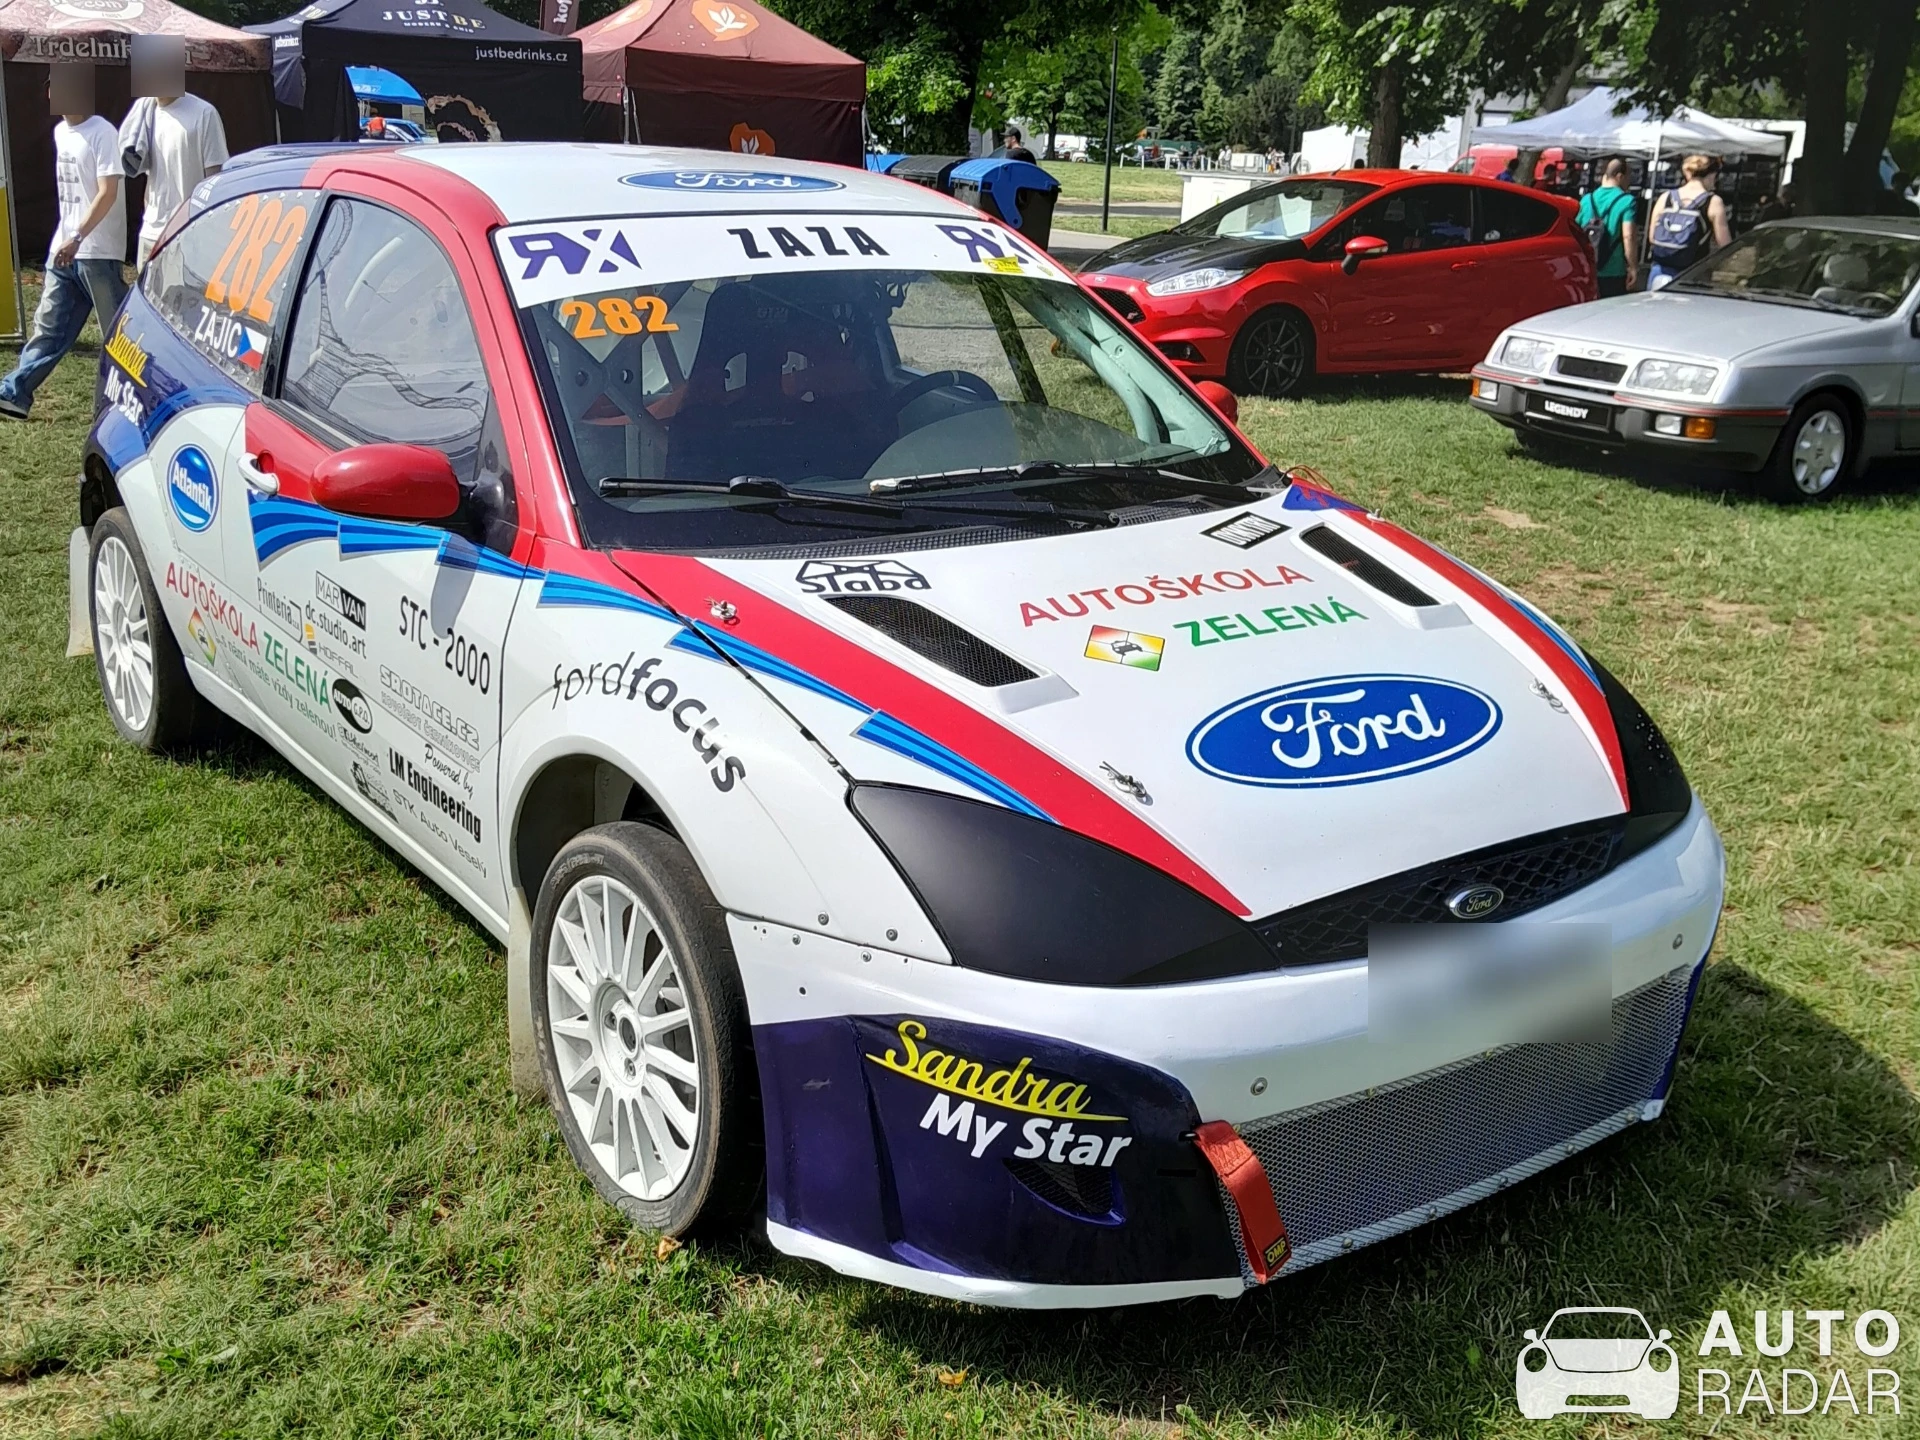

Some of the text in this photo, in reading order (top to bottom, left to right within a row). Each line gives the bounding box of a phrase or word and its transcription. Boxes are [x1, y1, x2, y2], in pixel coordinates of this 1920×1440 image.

[383, 10, 486, 29] JUST BE
[475, 46, 568, 62] justbedrinks.cz
[675, 172, 801, 188] Ford
[205, 194, 307, 323] 282
[726, 226, 891, 260] ZAZA
[561, 296, 680, 339] 282
[104, 366, 143, 426] My Star
[1544, 400, 1589, 419] LEGENDY
[172, 460, 212, 516] Atlantik
[257, 576, 293, 626] Printeria
[1019, 564, 1315, 628] AUTOŠKOLA
[1173, 595, 1370, 647] ZELENÁ
[166, 561, 332, 714] AUTOŠKOLA ZELENÁ
[305, 600, 367, 660] dc.studio.art
[399, 595, 428, 651] STC
[445, 627, 489, 695] 2000
[333, 688, 352, 711] AUTO
[379, 664, 480, 752] SROTACE.CZ
[1260, 688, 1446, 769] Ford
[388, 747, 406, 782] LM
[407, 760, 482, 844] Engineering
[424, 742, 462, 786] Powered
[463, 770, 475, 801] by
[392, 788, 418, 818] STK
[420, 811, 448, 843] Auto
[448, 832, 487, 879] Veselý
[1466, 893, 1493, 913] Ford
[884, 1020, 1092, 1116] Sandra
[919, 1092, 1132, 1168] My Star
[1266, 1240, 1287, 1264] OMP
